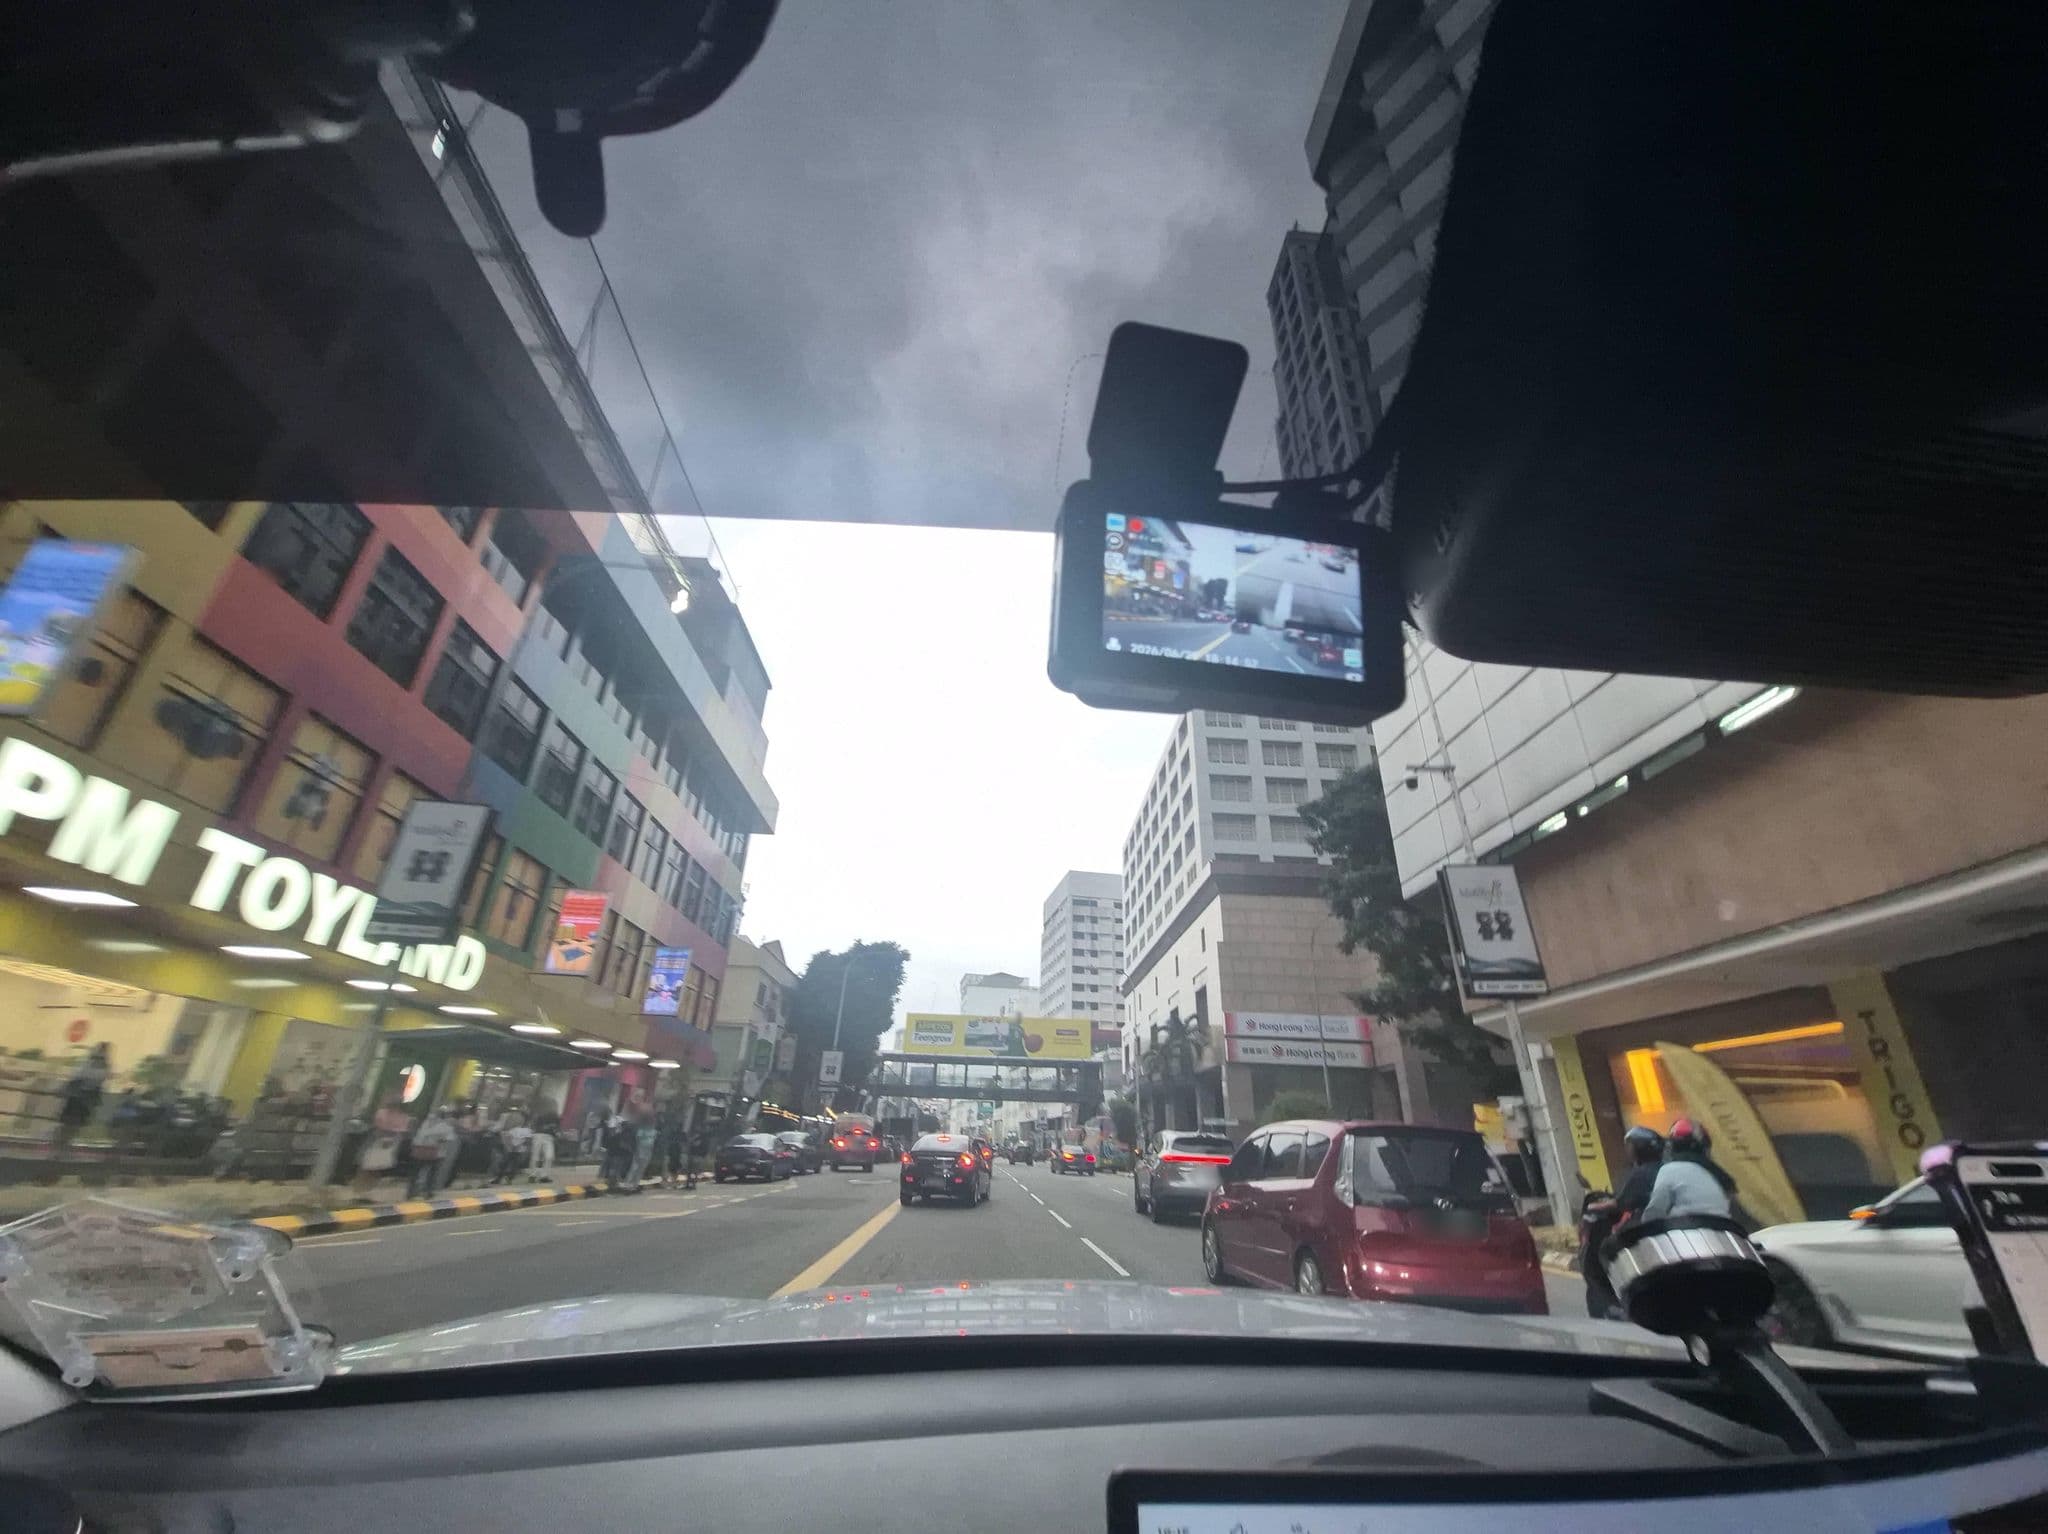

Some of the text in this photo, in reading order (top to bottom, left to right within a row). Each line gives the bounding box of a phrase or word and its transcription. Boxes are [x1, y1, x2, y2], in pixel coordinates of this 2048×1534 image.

[0, 736, 487, 992] PM TOYLND
[1858, 1010, 1925, 1149] TRIGO
